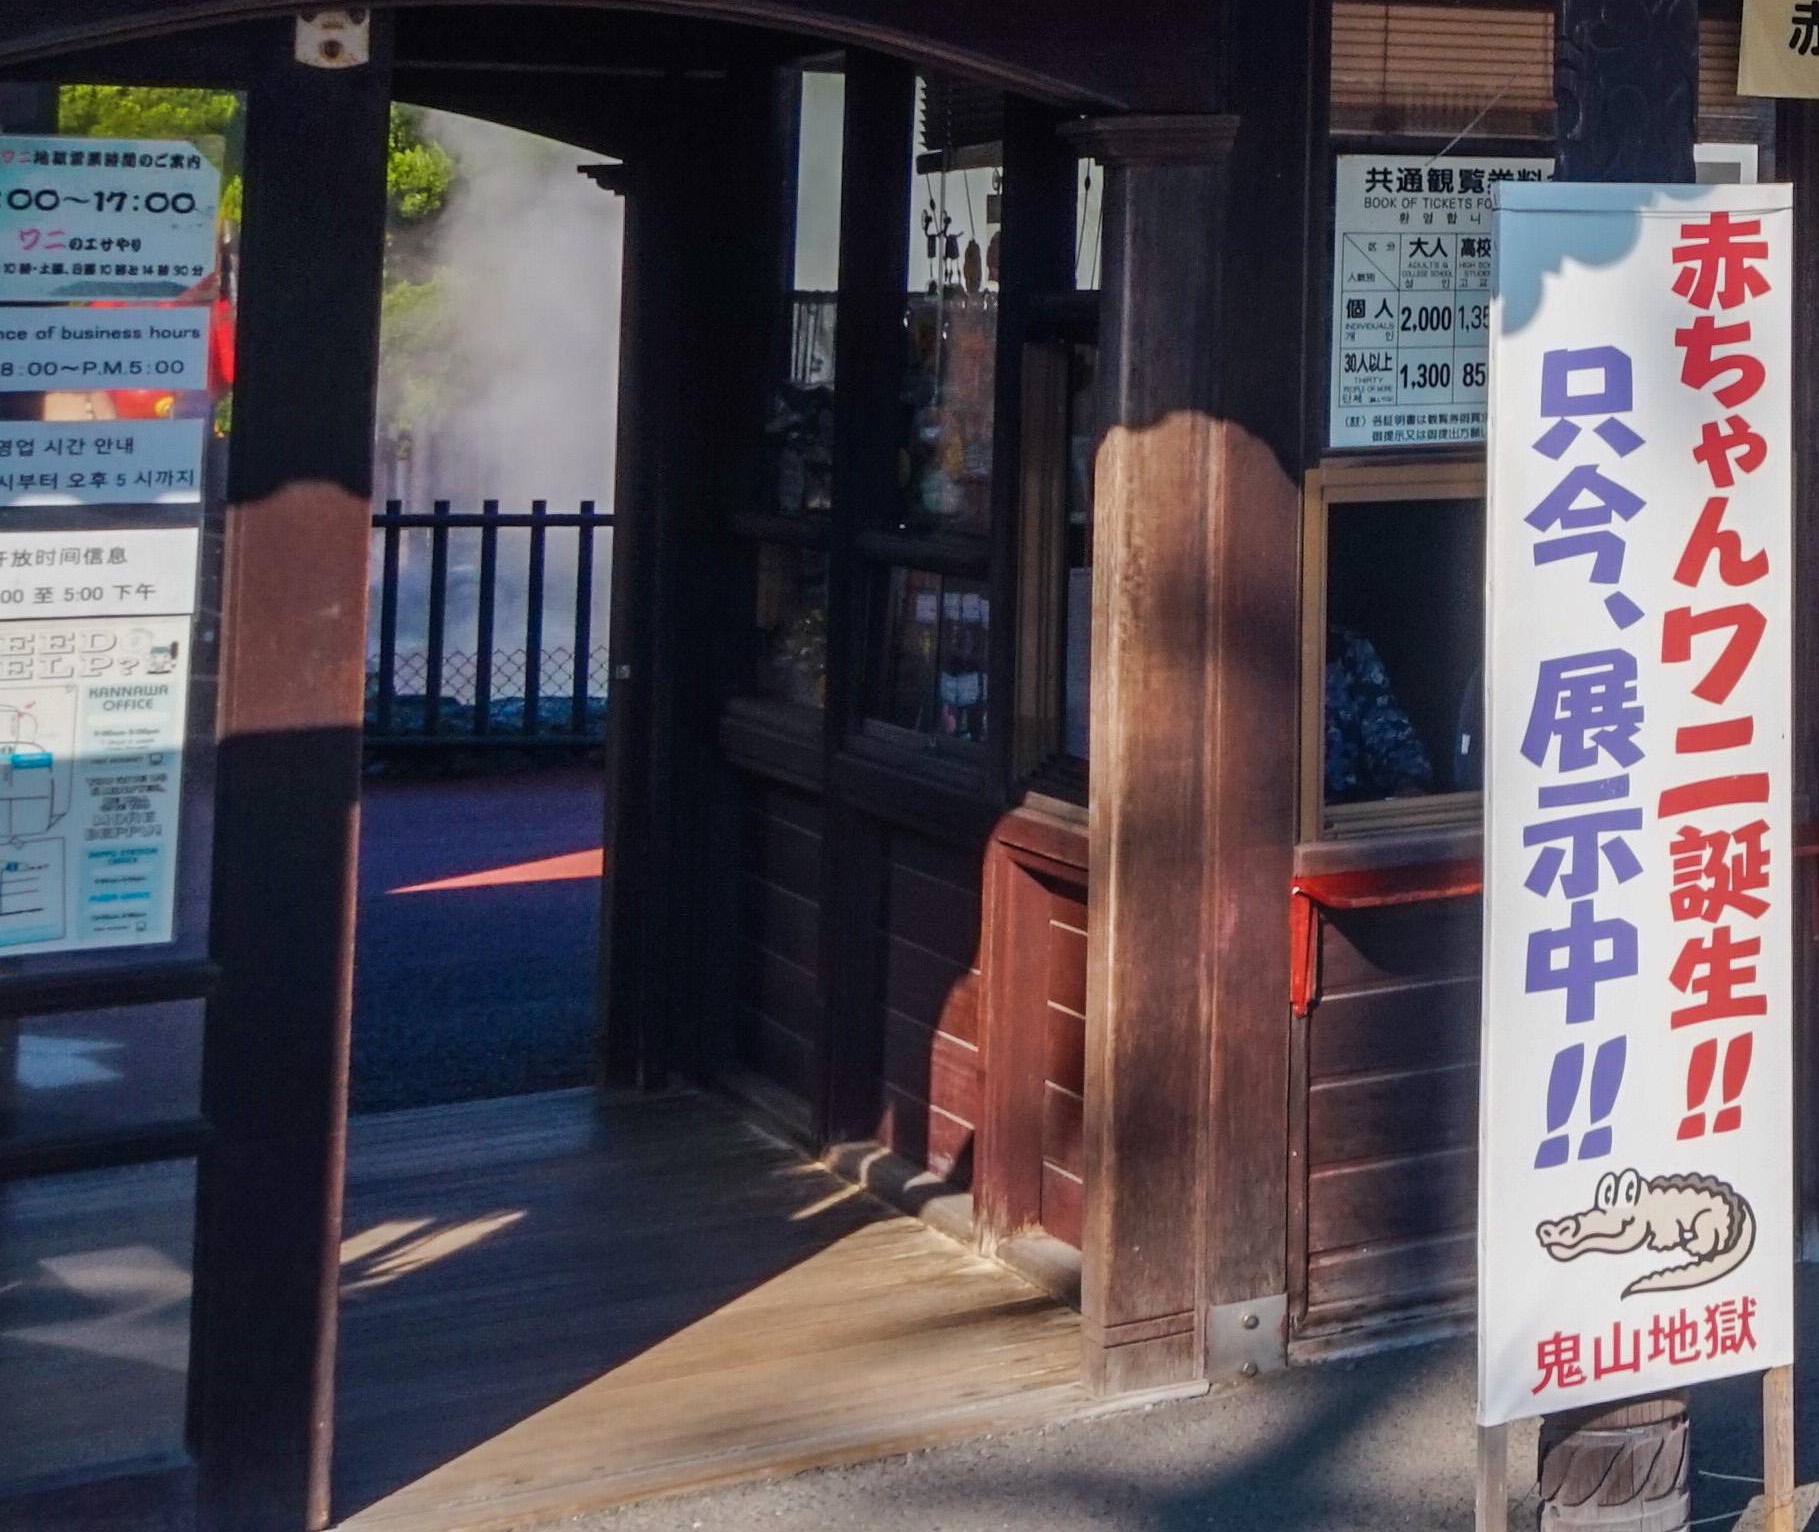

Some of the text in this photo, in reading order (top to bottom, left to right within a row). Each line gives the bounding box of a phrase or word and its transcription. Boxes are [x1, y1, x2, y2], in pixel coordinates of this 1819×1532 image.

[1364, 196, 1397, 210] BOOK
[1401, 197, 1418, 210] OF
[1422, 197, 1473, 210] TICKETS
[1408, 236, 1449, 259] 大人
[1346, 297, 1394, 320] 個人
[1400, 306, 1451, 333] 2,000
[35, 326, 55, 341] of
[61, 326, 142, 340] business
[150, 325, 201, 339] hours
[1344, 351, 1393, 374] 30人以上
[1399, 363, 1451, 390] 1,300
[44, 437, 87, 456] 시간
[94, 436, 135, 455] 안내
[67, 471, 108, 489] 오후
[115, 474, 127, 487] 5
[135, 469, 194, 488] 시까지
[33, 586, 54, 605] 至
[63, 586, 104, 602] 5:00
[113, 582, 157, 601] 下午
[88, 684, 169, 699] KANNAWA
[102, 698, 154, 713] OFFICE
[1531, 1297, 1758, 1396] 鬼山地獄
